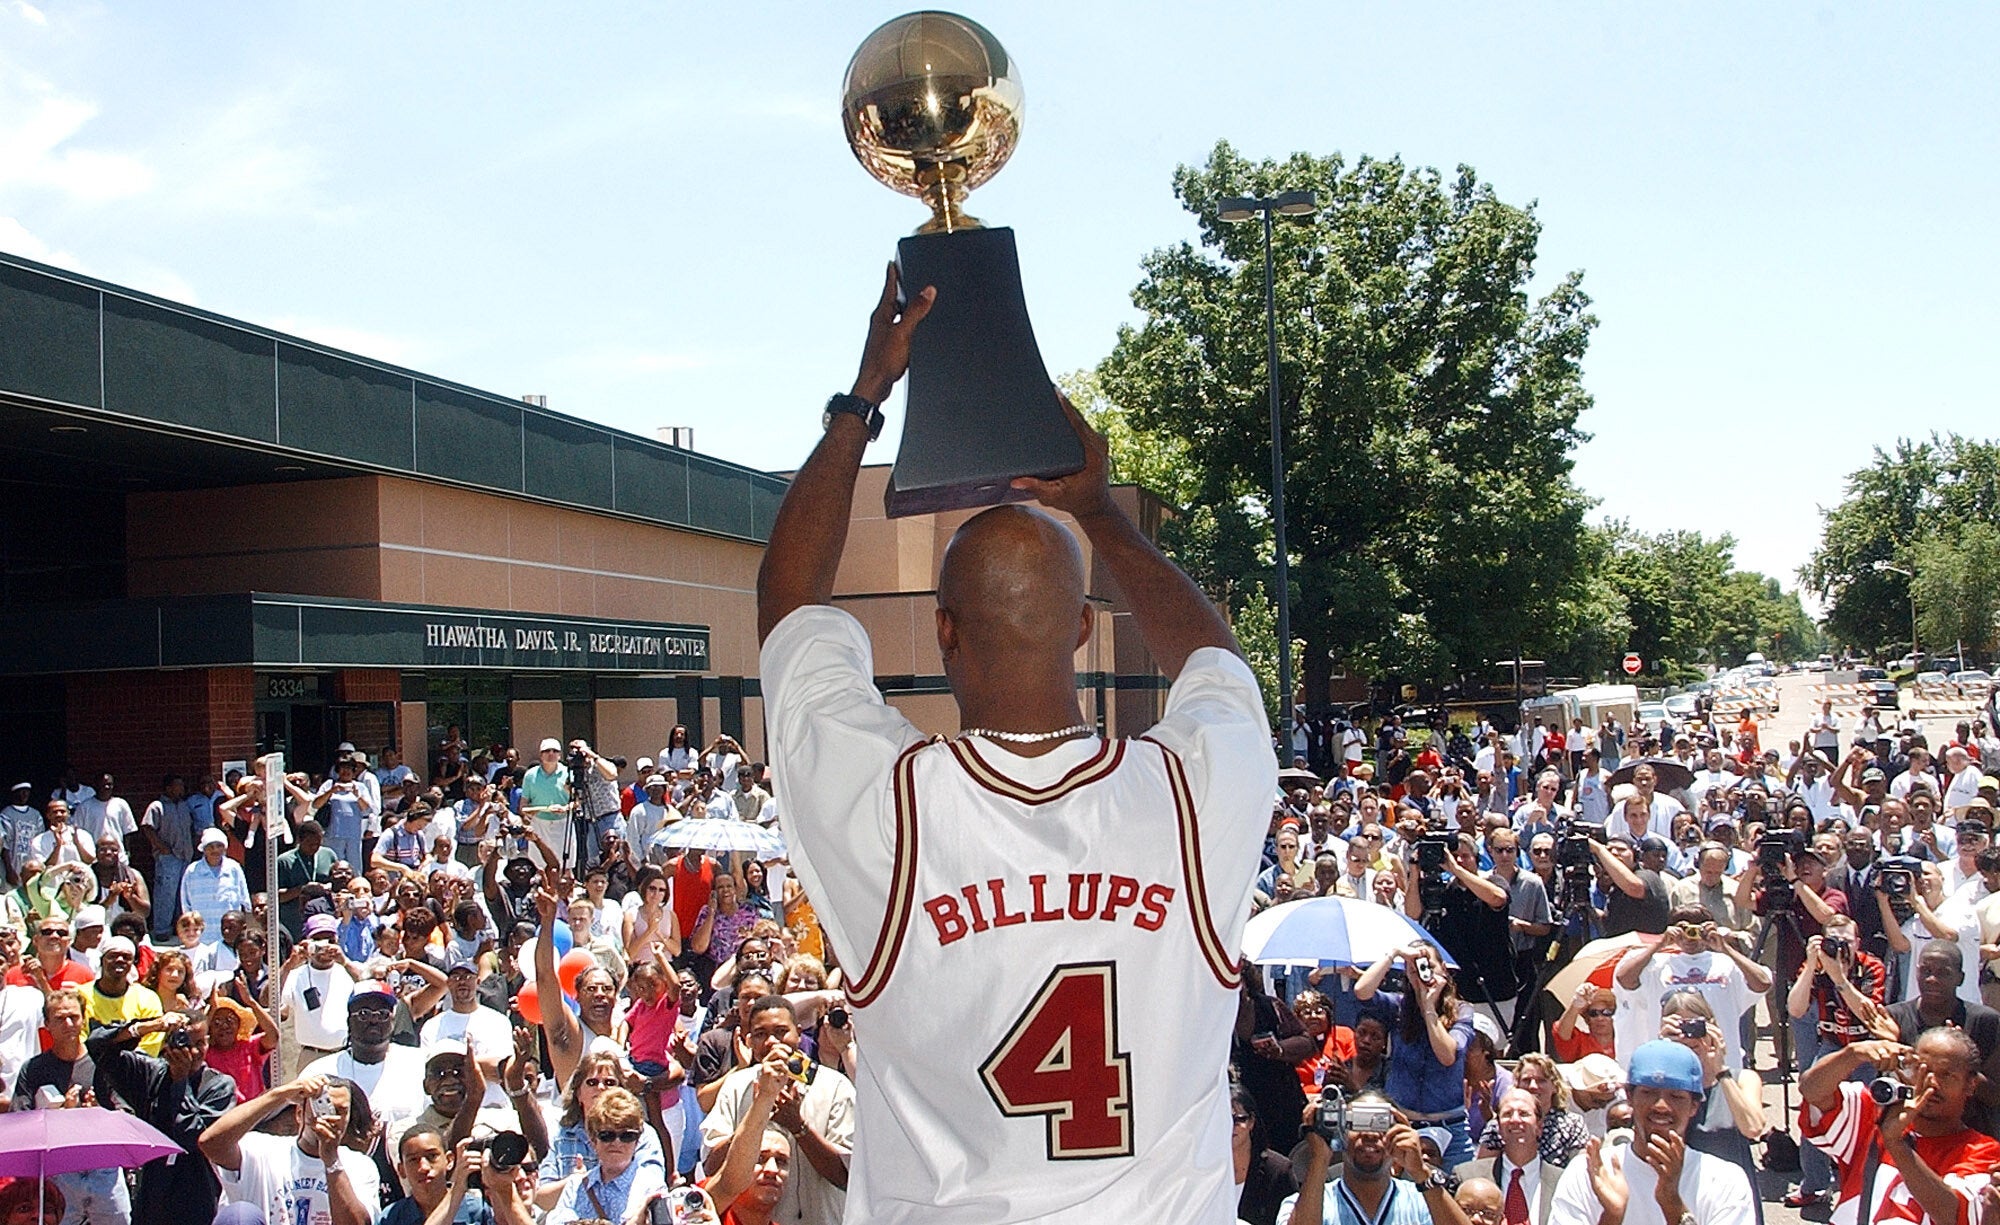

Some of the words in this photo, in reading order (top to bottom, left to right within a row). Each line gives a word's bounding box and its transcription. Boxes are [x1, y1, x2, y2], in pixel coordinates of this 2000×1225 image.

[426, 624, 507, 649] HIAWATHA
[515, 629, 558, 654] DAVIS,
[563, 631, 582, 652] JR.
[589, 633, 661, 655] RECREATION
[665, 637, 706, 657] CENTER
[270, 679, 305, 697] 3334
[923, 872, 1175, 946] BILLUPS
[977, 960, 1135, 1161] 4
